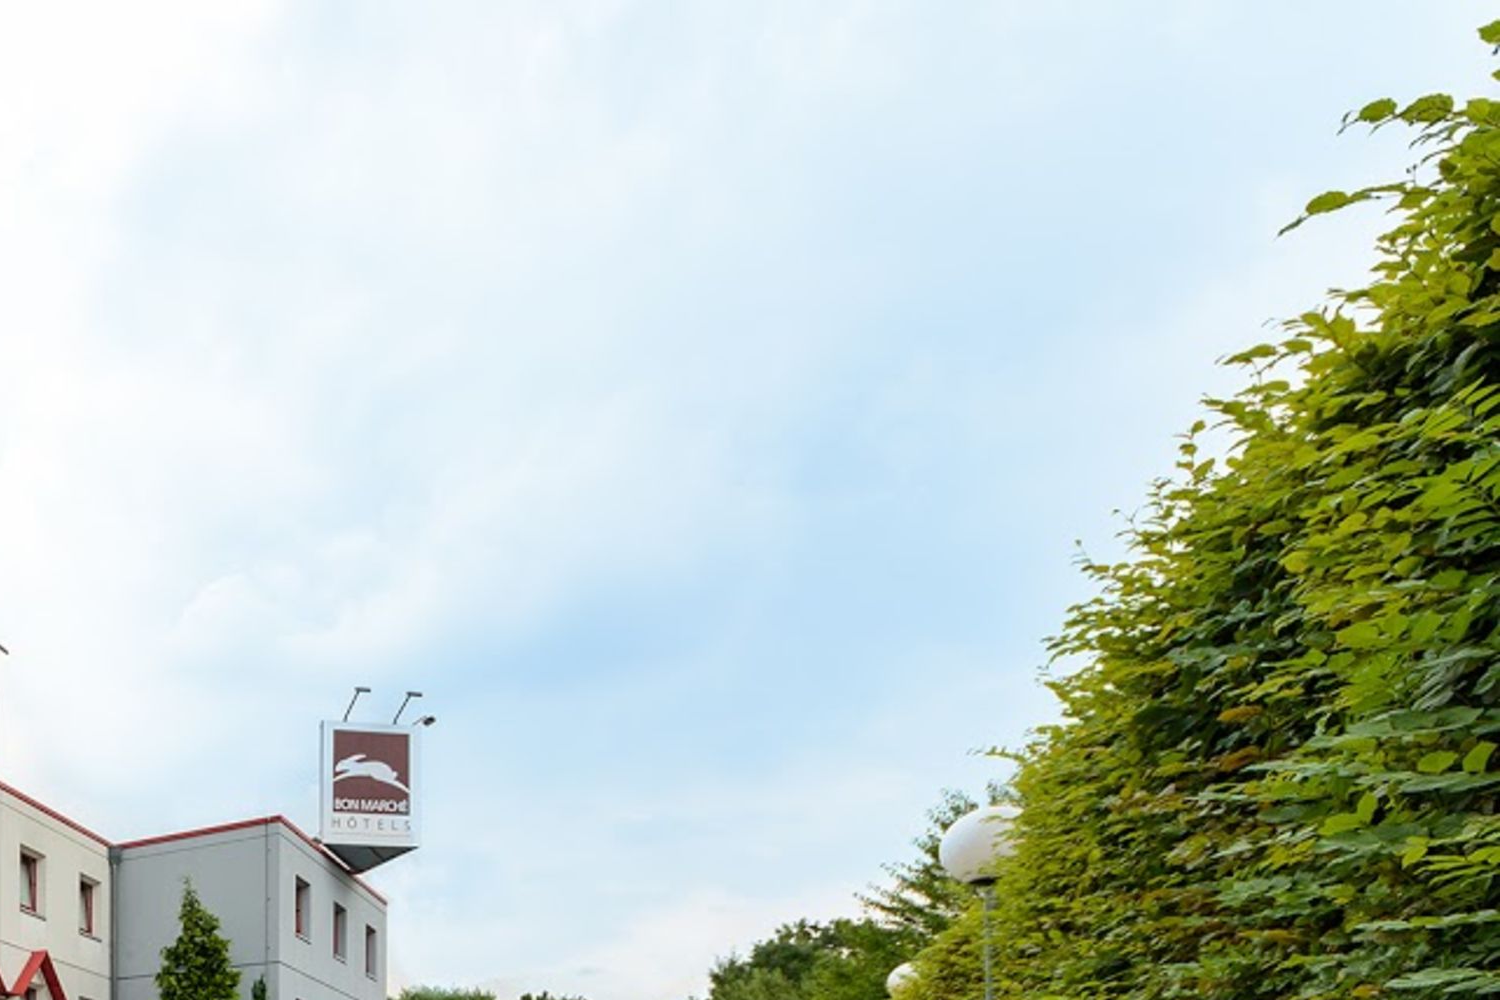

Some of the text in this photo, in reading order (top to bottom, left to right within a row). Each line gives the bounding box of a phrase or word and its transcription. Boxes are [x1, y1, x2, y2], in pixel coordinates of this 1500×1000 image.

[335, 798, 407, 812] BON MARCHÉ
[332, 816, 411, 832] HÔTELS
